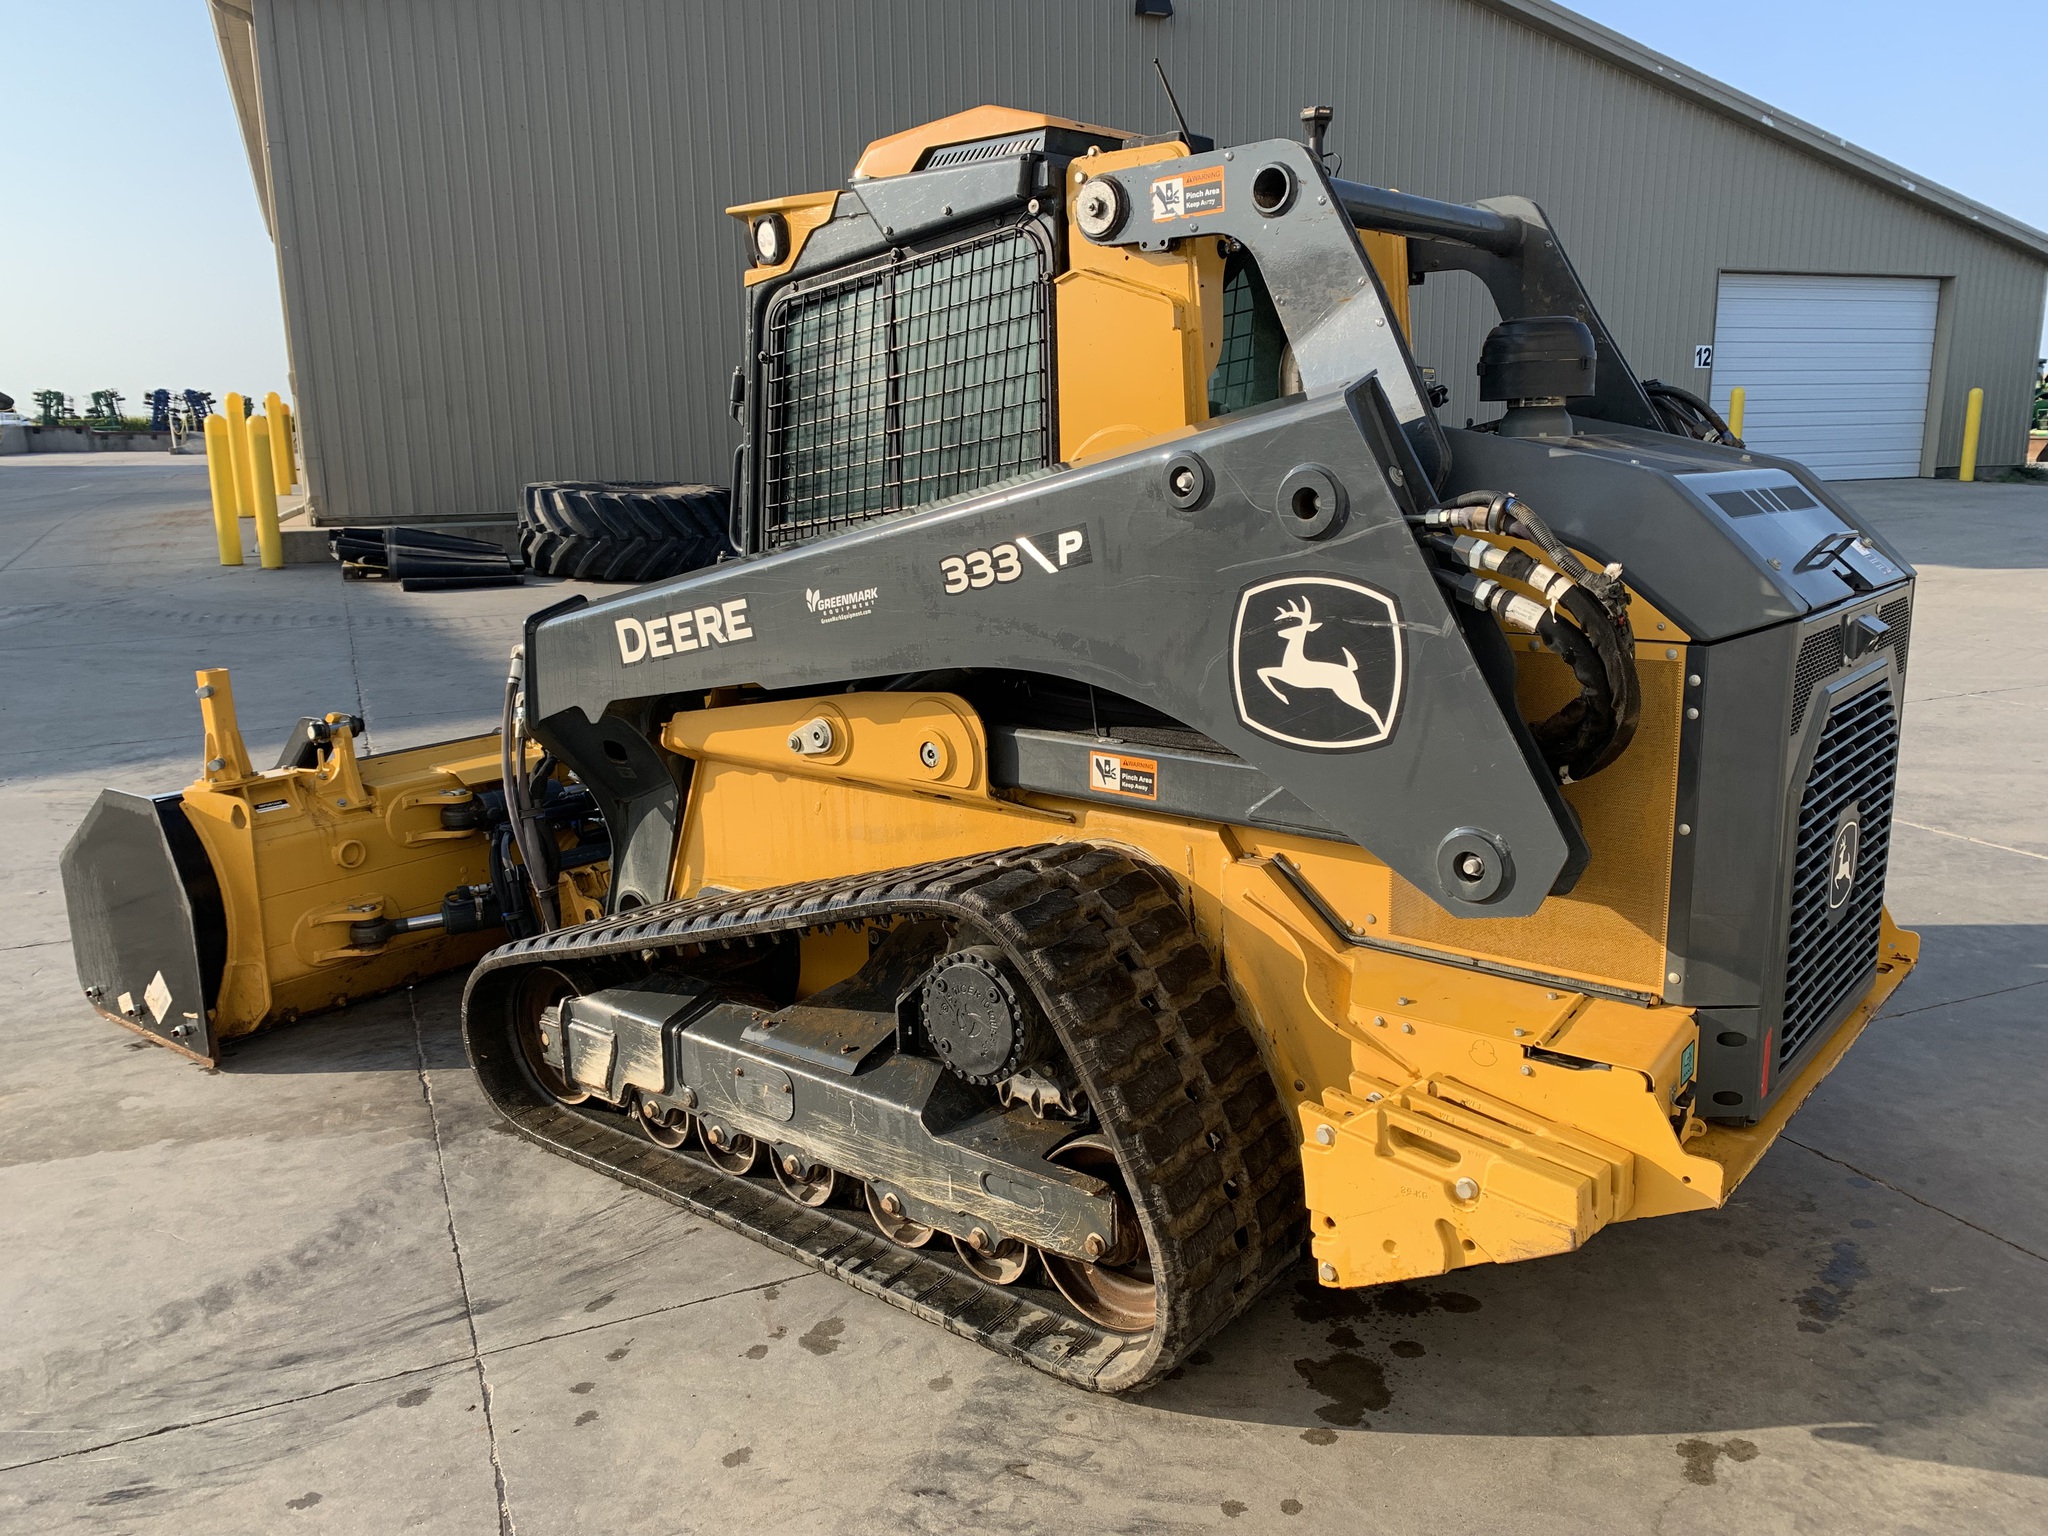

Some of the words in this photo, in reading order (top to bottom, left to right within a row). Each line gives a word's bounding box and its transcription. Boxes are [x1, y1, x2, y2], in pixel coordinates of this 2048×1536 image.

[1191, 171, 1221, 182] WARNING
[1186, 190, 1204, 199] Pinch
[1205, 187, 1220, 196] Area
[1185, 201, 1200, 209] Keep
[1696, 347, 1711, 366] 12
[941, 544, 1022, 594] 333
[1058, 530, 1083, 566] P
[817, 586, 878, 611] GREENMARK
[822, 600, 875, 616] EQUIPMENT
[614, 598, 753, 665] DEERE
[1128, 761, 1154, 770] WARNING
[1121, 773, 1139, 782] Pinch
[1138, 776, 1152, 784] Area
[1134, 784, 1148, 792] Away
